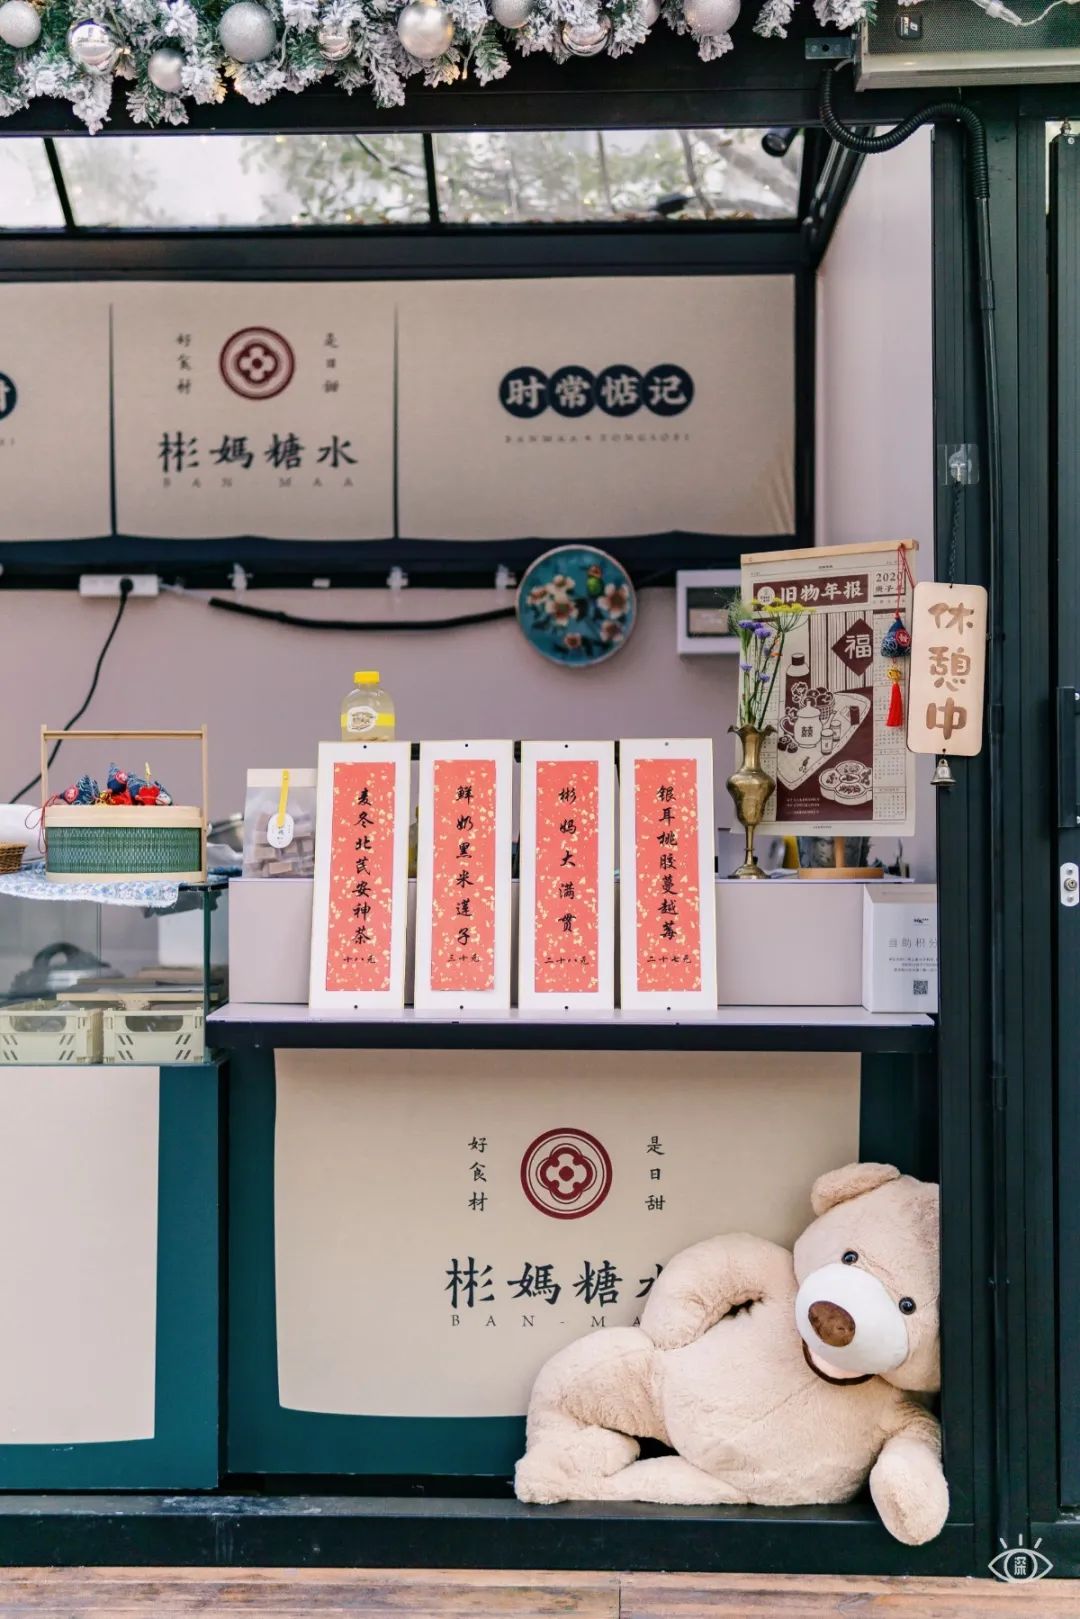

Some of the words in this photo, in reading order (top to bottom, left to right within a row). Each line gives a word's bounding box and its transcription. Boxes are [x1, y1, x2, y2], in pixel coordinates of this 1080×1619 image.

[504, 372, 689, 411] 时常惦记
[158, 431, 358, 473] 彬媽糖水
[876, 570, 903, 583] 2020
[780, 580, 865, 603] 旧物年报
[844, 634, 872, 660] 福
[925, 602, 975, 741] 休憩中
[557, 787, 577, 933] 彬妈大满贯
[342, 954, 377, 964] 十八元
[448, 953, 481, 963] 三十元
[544, 955, 590, 965] 二十八元
[646, 954, 692, 964] 二十七元
[467, 1135, 488, 1212] 好食材
[645, 1135, 666, 1212] 是日甜
